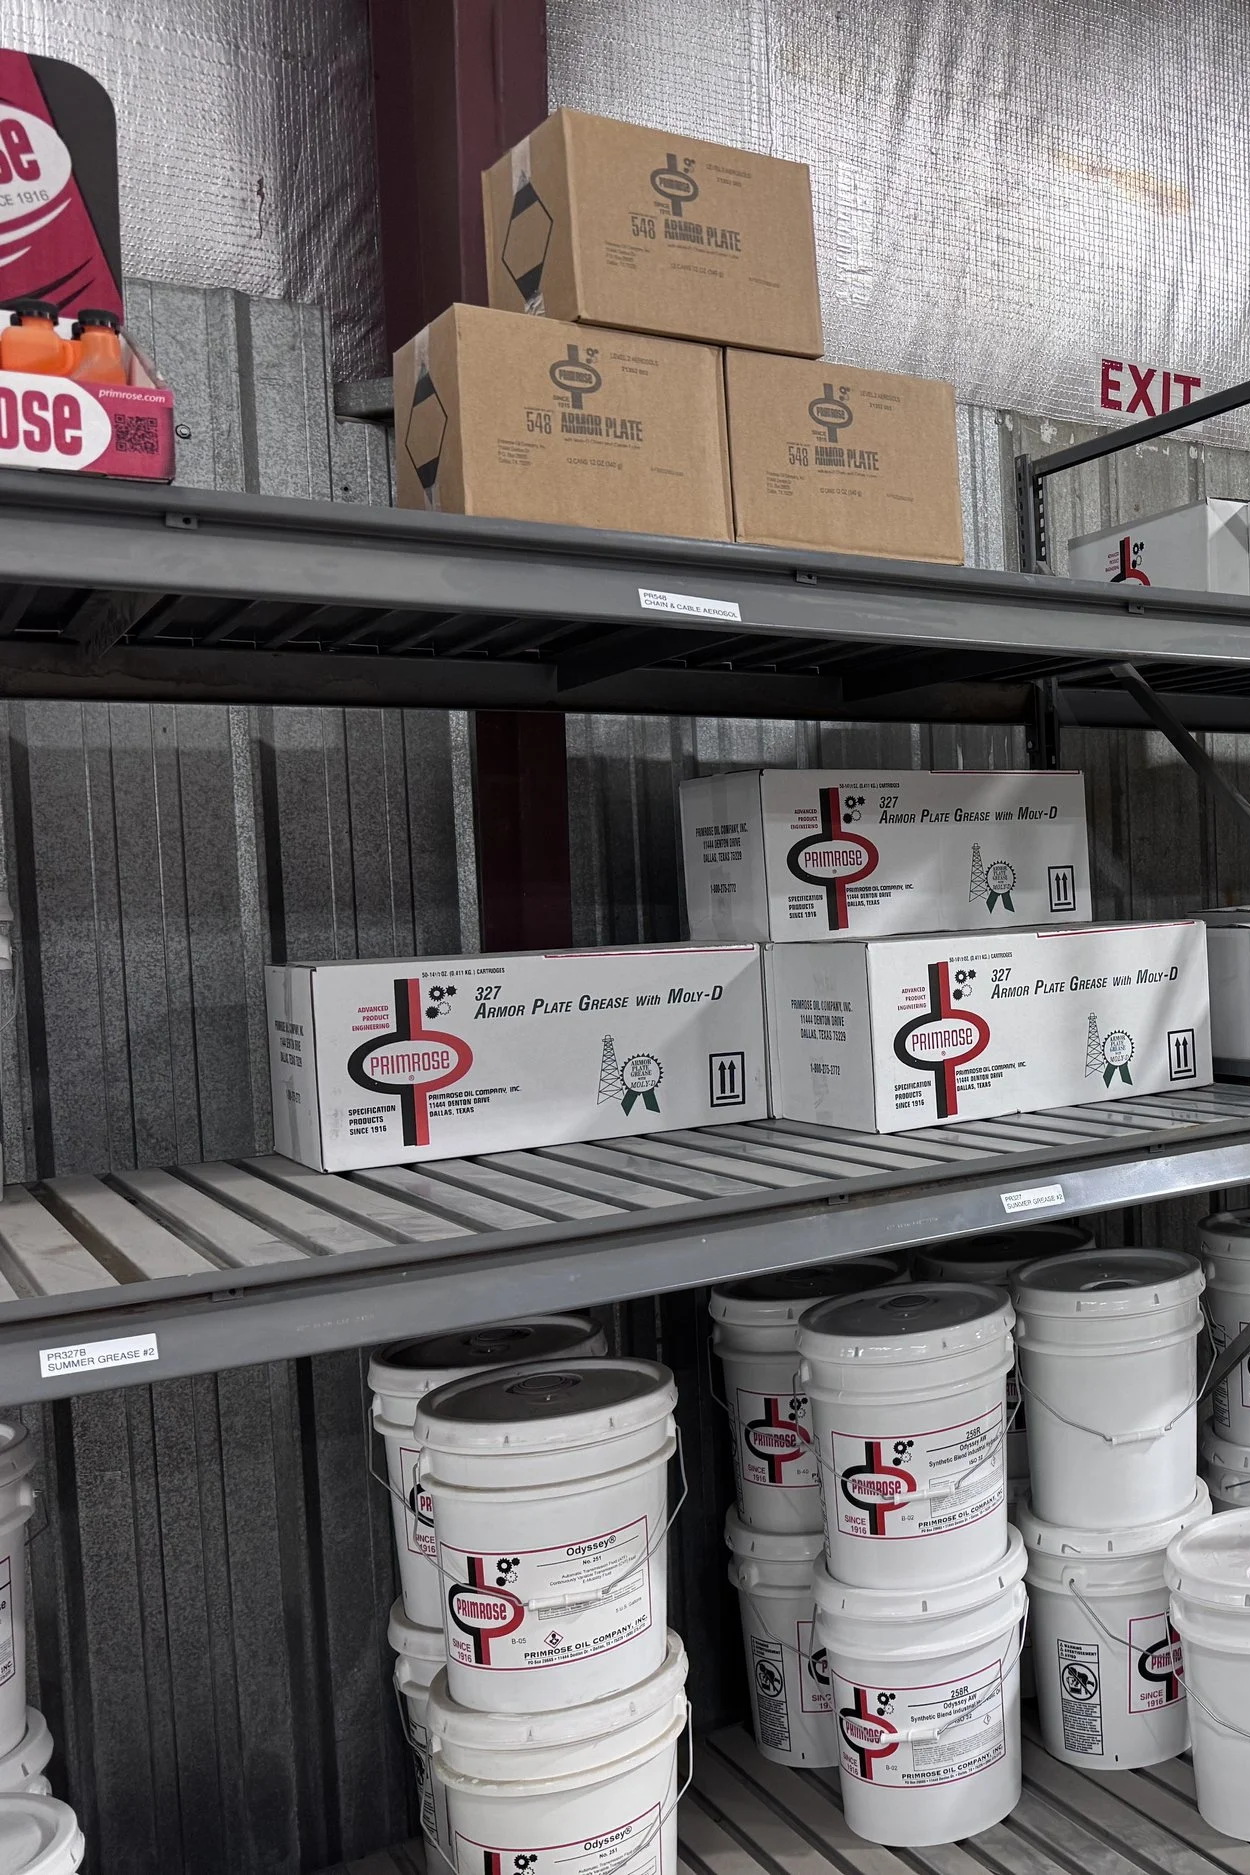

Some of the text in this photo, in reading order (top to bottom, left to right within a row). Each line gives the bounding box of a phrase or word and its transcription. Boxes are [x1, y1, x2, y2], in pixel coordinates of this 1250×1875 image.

[17, 190, 49, 204] 1916
[631, 216, 741, 252] 548 ARMOR PLATE
[1101, 359, 1201, 417] EXIT
[99, 389, 165, 403] primrose.com
[526, 411, 643, 442] 548 ARMOR PLATE
[788, 446, 879, 471] 548 ARMOR PLATE
[644, 599, 668, 608] CHAIN
[677, 604, 701, 612] CABLE
[703, 607, 737, 618] AEROSOL
[879, 796, 899, 809] 327
[879, 806, 1058, 824] ARMOR PLATE GREASE With MOLY-D
[805, 850, 862, 868] PRIMROSE
[789, 903, 814, 911] PRODUCTS
[991, 951, 1013, 959] CARTRIDGES
[991, 968, 1012, 983] 327
[991, 966, 1179, 999] ARMOR PLATE GREASE With MOLY-D
[475, 985, 502, 1001] 327
[902, 986, 926, 994] ADVANCED
[474, 985, 723, 1020] ARMOR PLATE GREASE With MOLY-D
[905, 994, 926, 1002] PRODUCT
[897, 1003, 927, 1011] ENGINEERING
[362, 1014, 389, 1022] PRODUCT
[352, 1023, 390, 1031] ENGINEERING
[912, 1027, 973, 1052] PRIMROSE
[370, 1050, 450, 1076] PRIMROSE
[810, 1063, 841, 1076] 1-800-275-2772
[894, 1080, 932, 1091] SPECIFICATION
[956, 1084, 976, 1092] DALLAS,
[428, 1091, 463, 1100] PRIMROSE
[475, 1087, 508, 1097] COMPANY,
[895, 1090, 922, 1101] PRODUCTS
[429, 1097, 490, 1109] 11444 DENTON DRIVE
[895, 1099, 925, 1110] SINCE 1916
[348, 1105, 396, 1116] SPECIFICATION
[429, 1109, 455, 1117] DALLAS,
[349, 1116, 384, 1126] PRODUCTS
[349, 1127, 369, 1135] SINCE
[47, 1349, 86, 1361] PR327B
[48, 1348, 155, 1371] SUMMER GREASE #2
[753, 1432, 796, 1447] PRIMROSE
[966, 1427, 980, 1439] 258R
[960, 1438, 978, 1451] Odyssey
[748, 1464, 765, 1474] SINCE
[753, 1474, 766, 1482] 1916
[852, 1479, 901, 1496] PRIMROSE
[918, 1496, 995, 1528] PRIMROSE OIL COMPANY,
[845, 1515, 866, 1525] SINCE
[851, 1525, 866, 1534] 1916
[566, 1535, 616, 1556] Odyssey®
[457, 1598, 507, 1621] PRIMROSE
[524, 1615, 648, 1659] PRIMROSE OIL COMPANY, INC.
[453, 1638, 471, 1653] SINCE
[458, 1651, 472, 1663] 1916
[950, 1686, 969, 1698] 258R
[1140, 1689, 1163, 1701] SINCE
[943, 1694, 977, 1709] Odyssey AW
[1147, 1700, 1163, 1708] 1916
[842, 1752, 858, 1767] SINCE
[584, 1826, 632, 1850] Odyssey®
